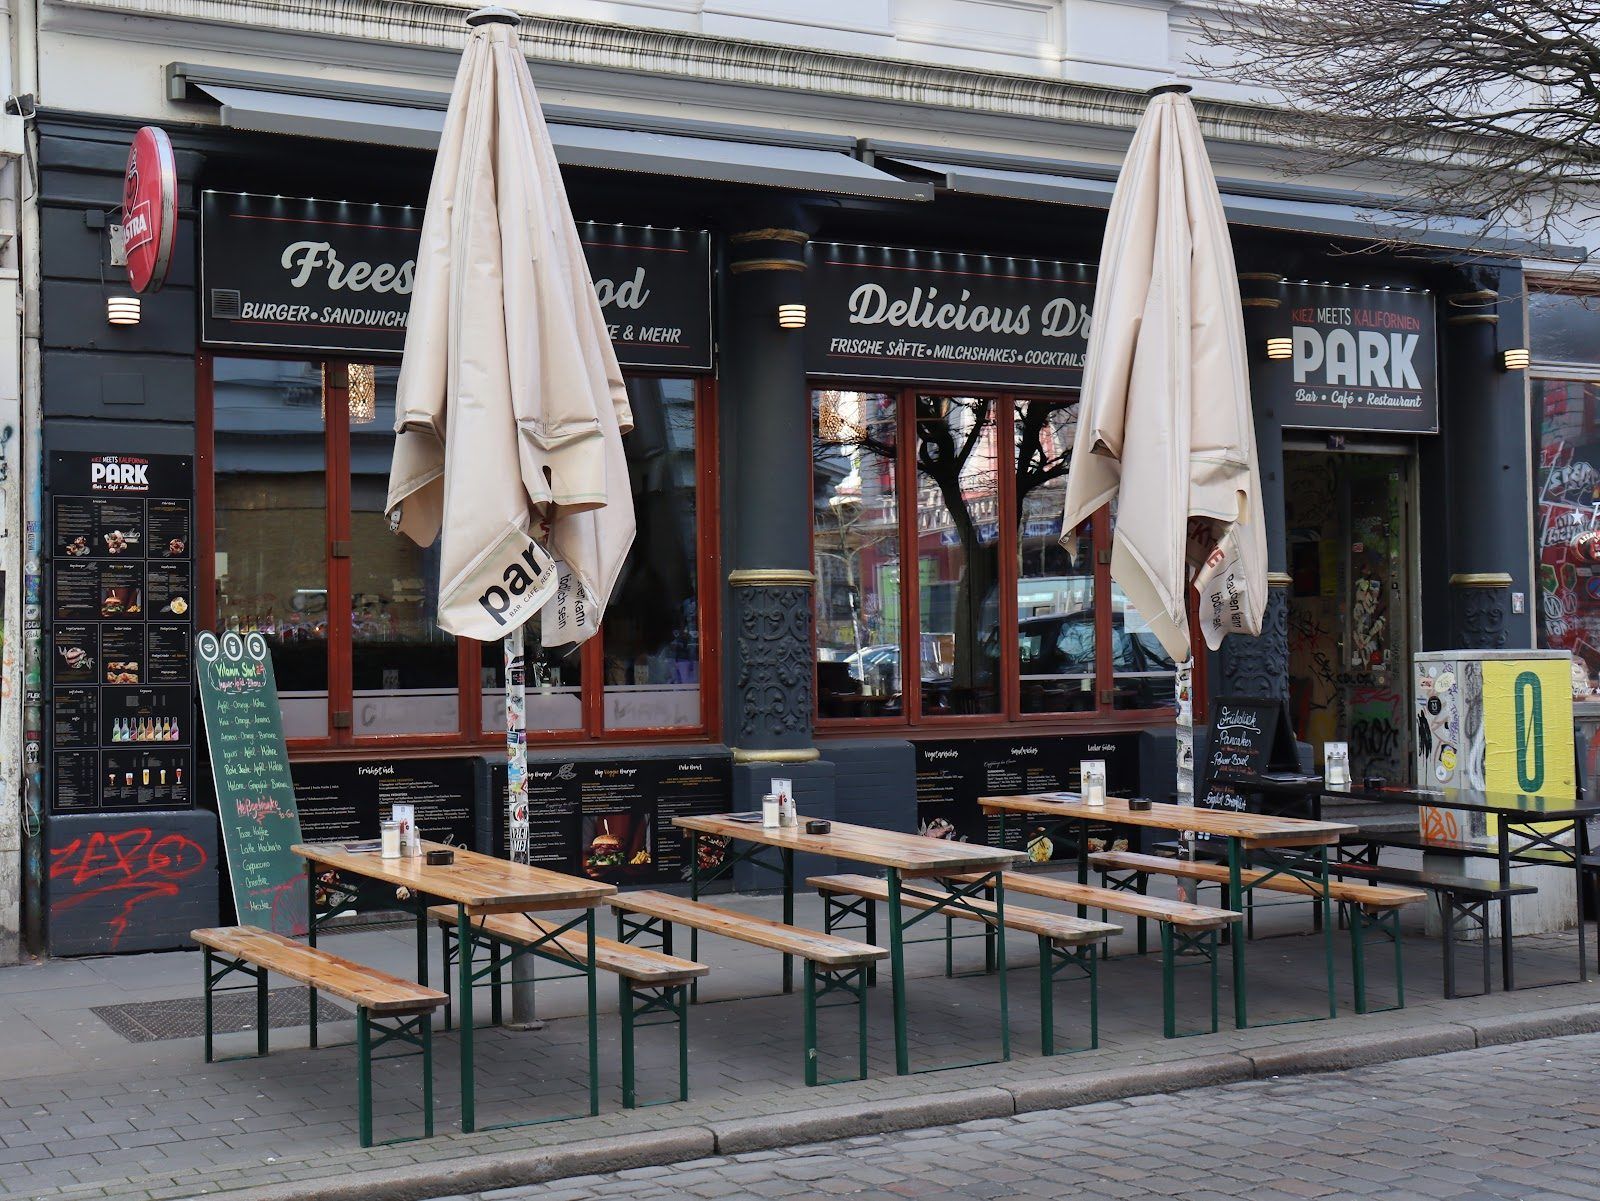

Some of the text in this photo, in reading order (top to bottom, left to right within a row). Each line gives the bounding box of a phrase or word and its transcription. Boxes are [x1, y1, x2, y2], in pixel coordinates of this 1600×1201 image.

[123, 213, 147, 244] STRA
[849, 283, 1031, 335] Delicious
[1292, 307, 1420, 330] KIEZ MEETS KALIFORNIEN
[241, 302, 310, 322] BURGER
[623, 325, 634, 340] &
[639, 326, 681, 343] MEHR
[830, 338, 1086, 368] FRISCHE SÄFTE MILCHSHAKES COCKTAILS
[1292, 325, 1422, 390] PARK
[1295, 388, 1422, 409] Bar Café Restaurant
[102, 455, 118, 463] MEETS
[91, 462, 149, 485] PARK
[509, 605, 522, 619] BAR
[541, 564, 556, 583] RESTA
[558, 606, 569, 630] sein
[215, 658, 240, 678] Vitamin
[1220, 730, 1251, 747] Pancakes
[358, 765, 394, 776] Frühstück
